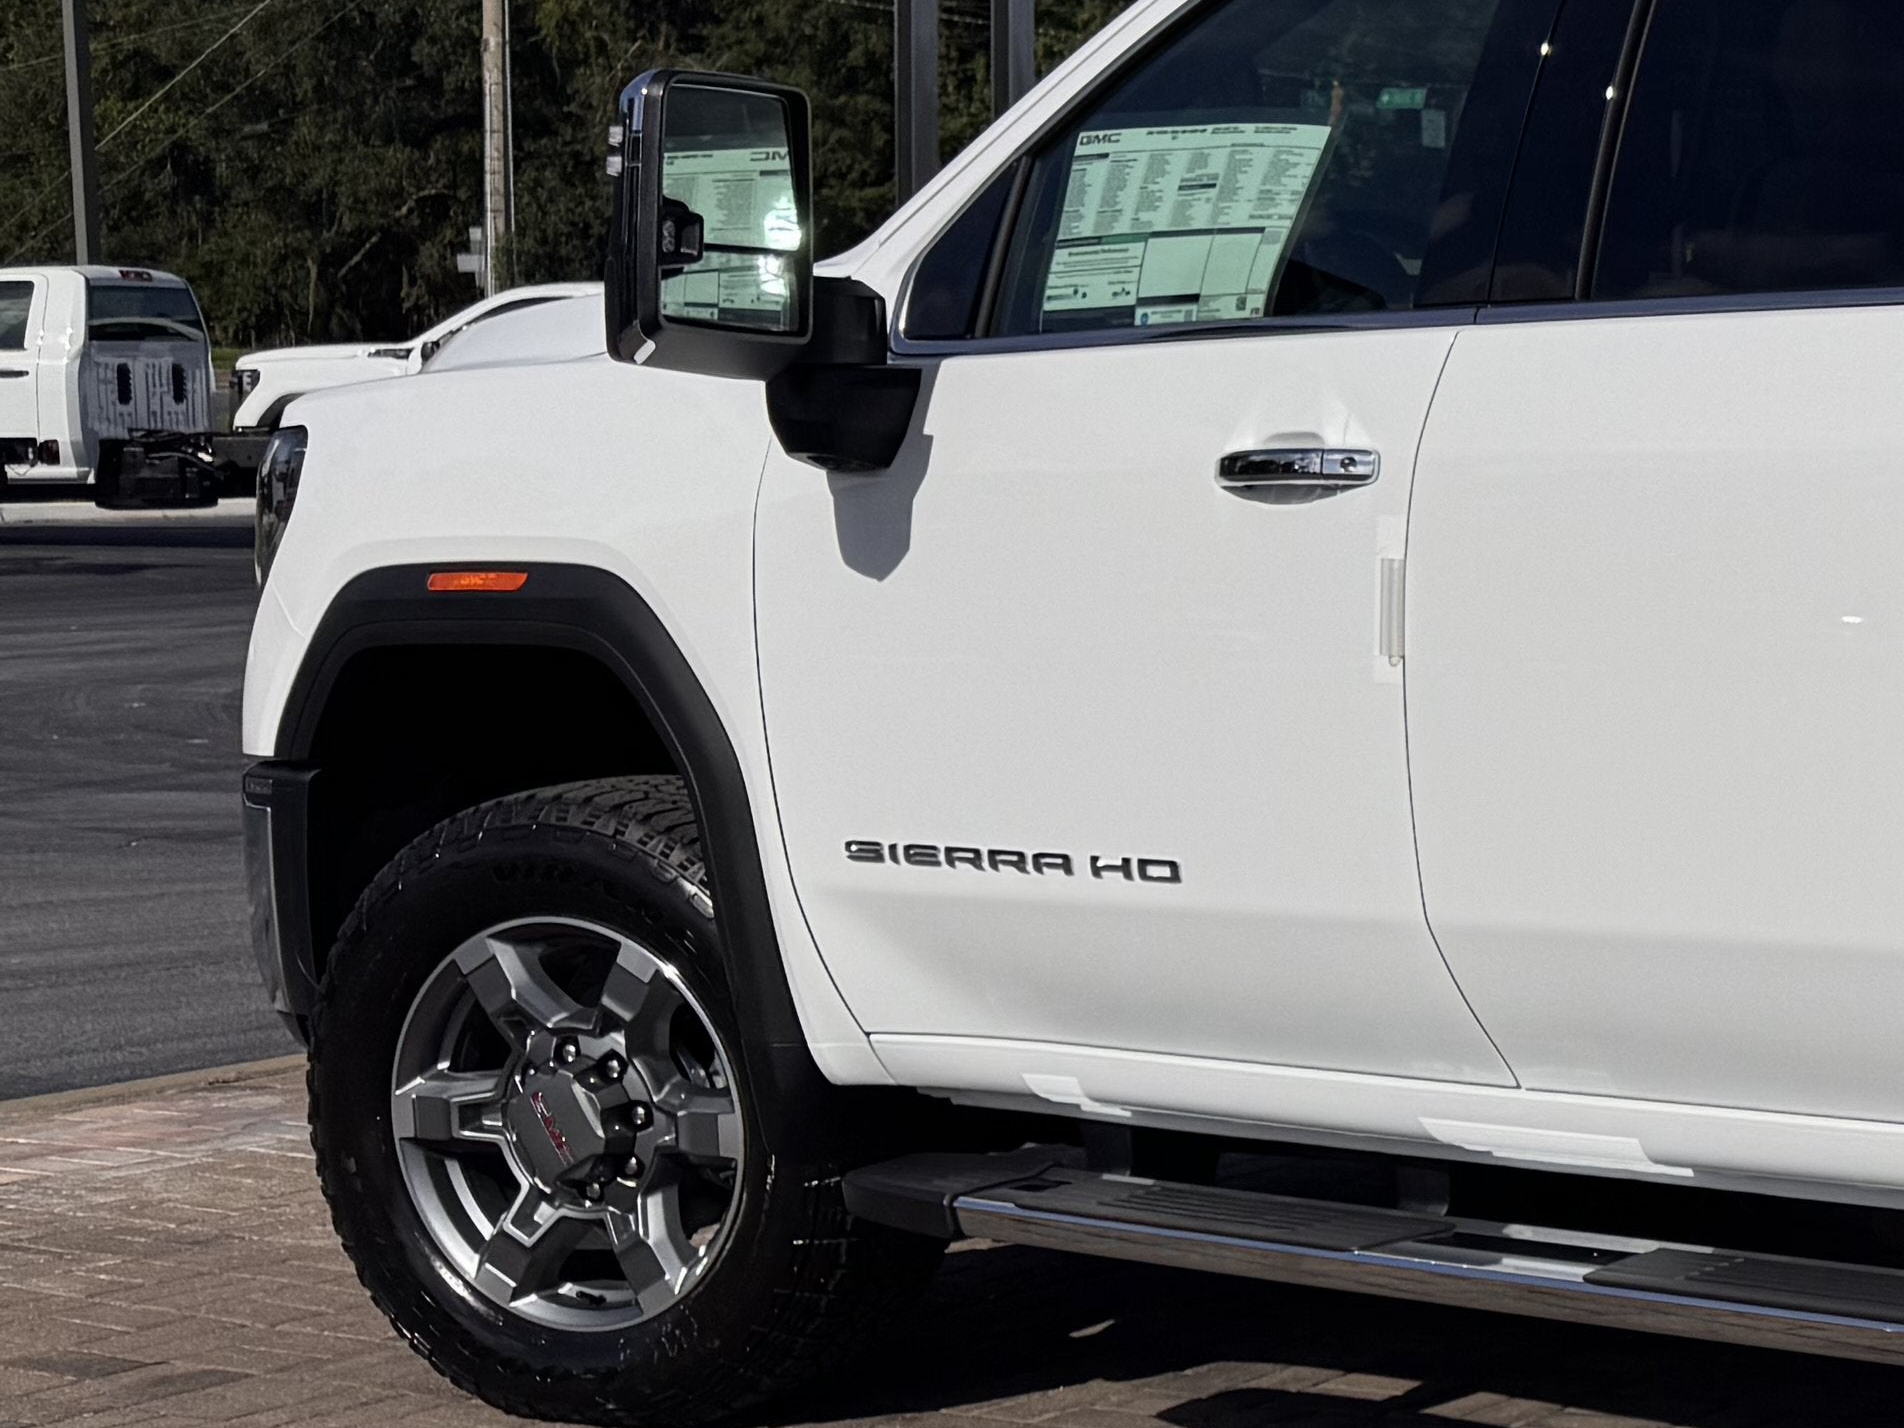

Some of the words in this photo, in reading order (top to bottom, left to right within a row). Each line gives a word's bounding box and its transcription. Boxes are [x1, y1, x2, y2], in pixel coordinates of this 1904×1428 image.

[1079, 133, 1122, 146] GMC
[844, 840, 1075, 876] SIERRA
[1090, 855, 1182, 884] HD
